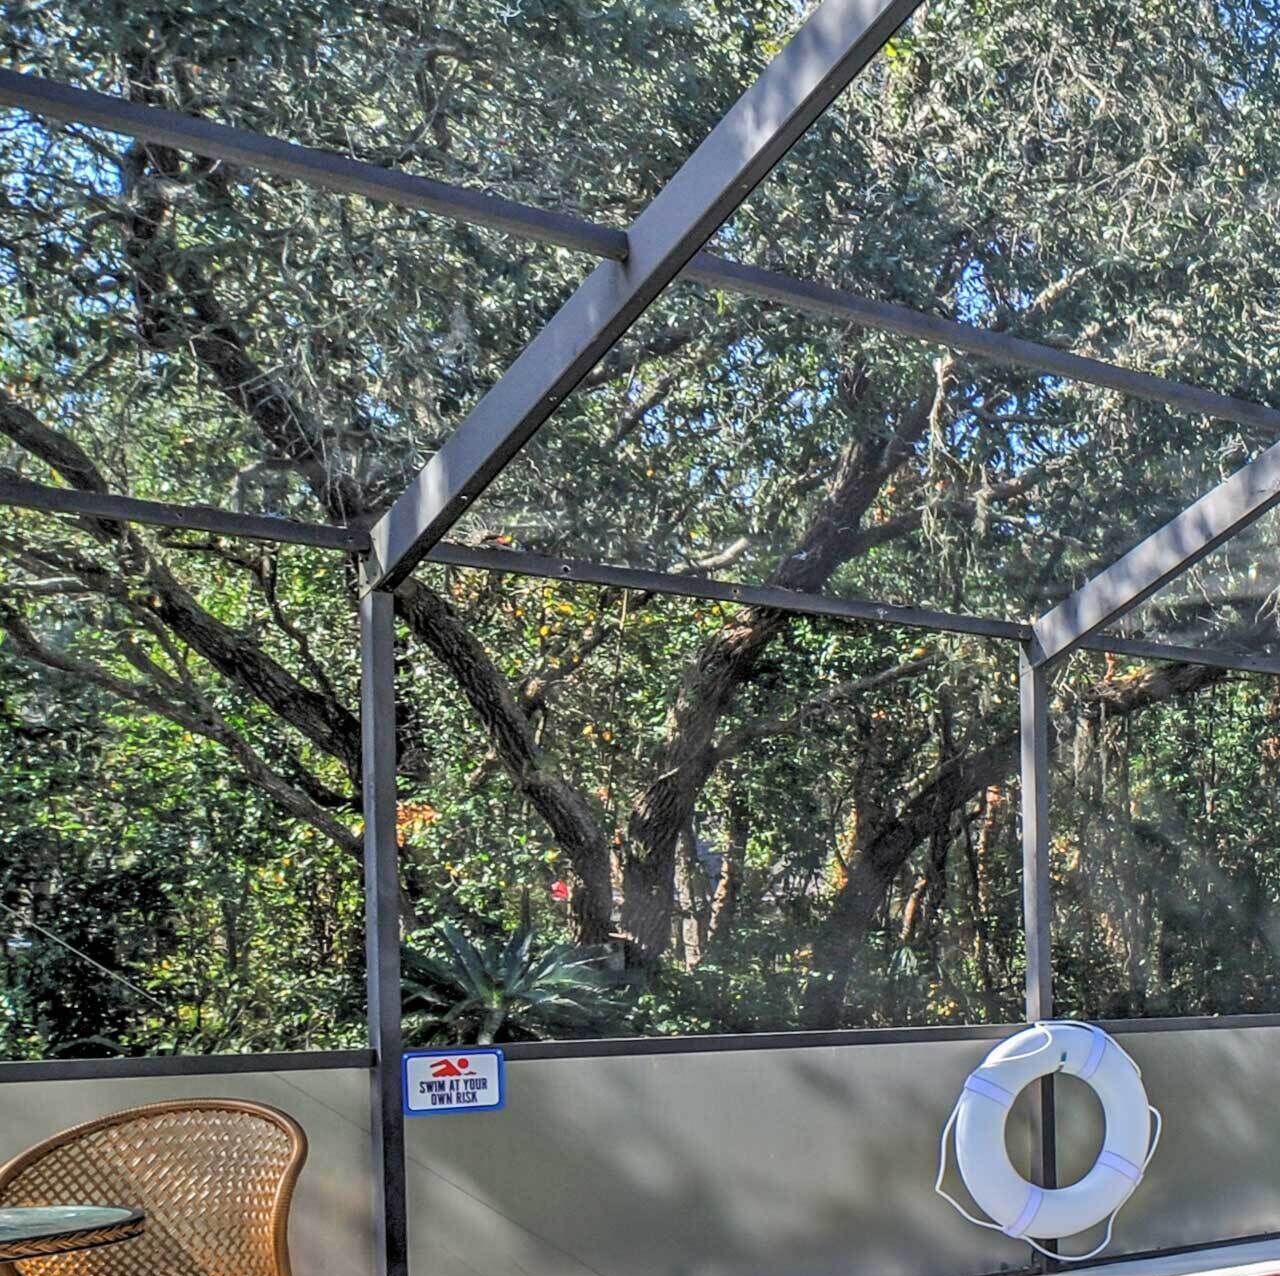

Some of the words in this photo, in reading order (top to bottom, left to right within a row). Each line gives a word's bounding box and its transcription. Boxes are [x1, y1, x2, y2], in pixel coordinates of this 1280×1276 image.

[419, 1080, 445, 1094] SWIM
[449, 1079, 460, 1092] AT
[463, 1078, 488, 1090] YOUR
[431, 1093, 453, 1105] OWN
[456, 1091, 478, 1103] RISK
